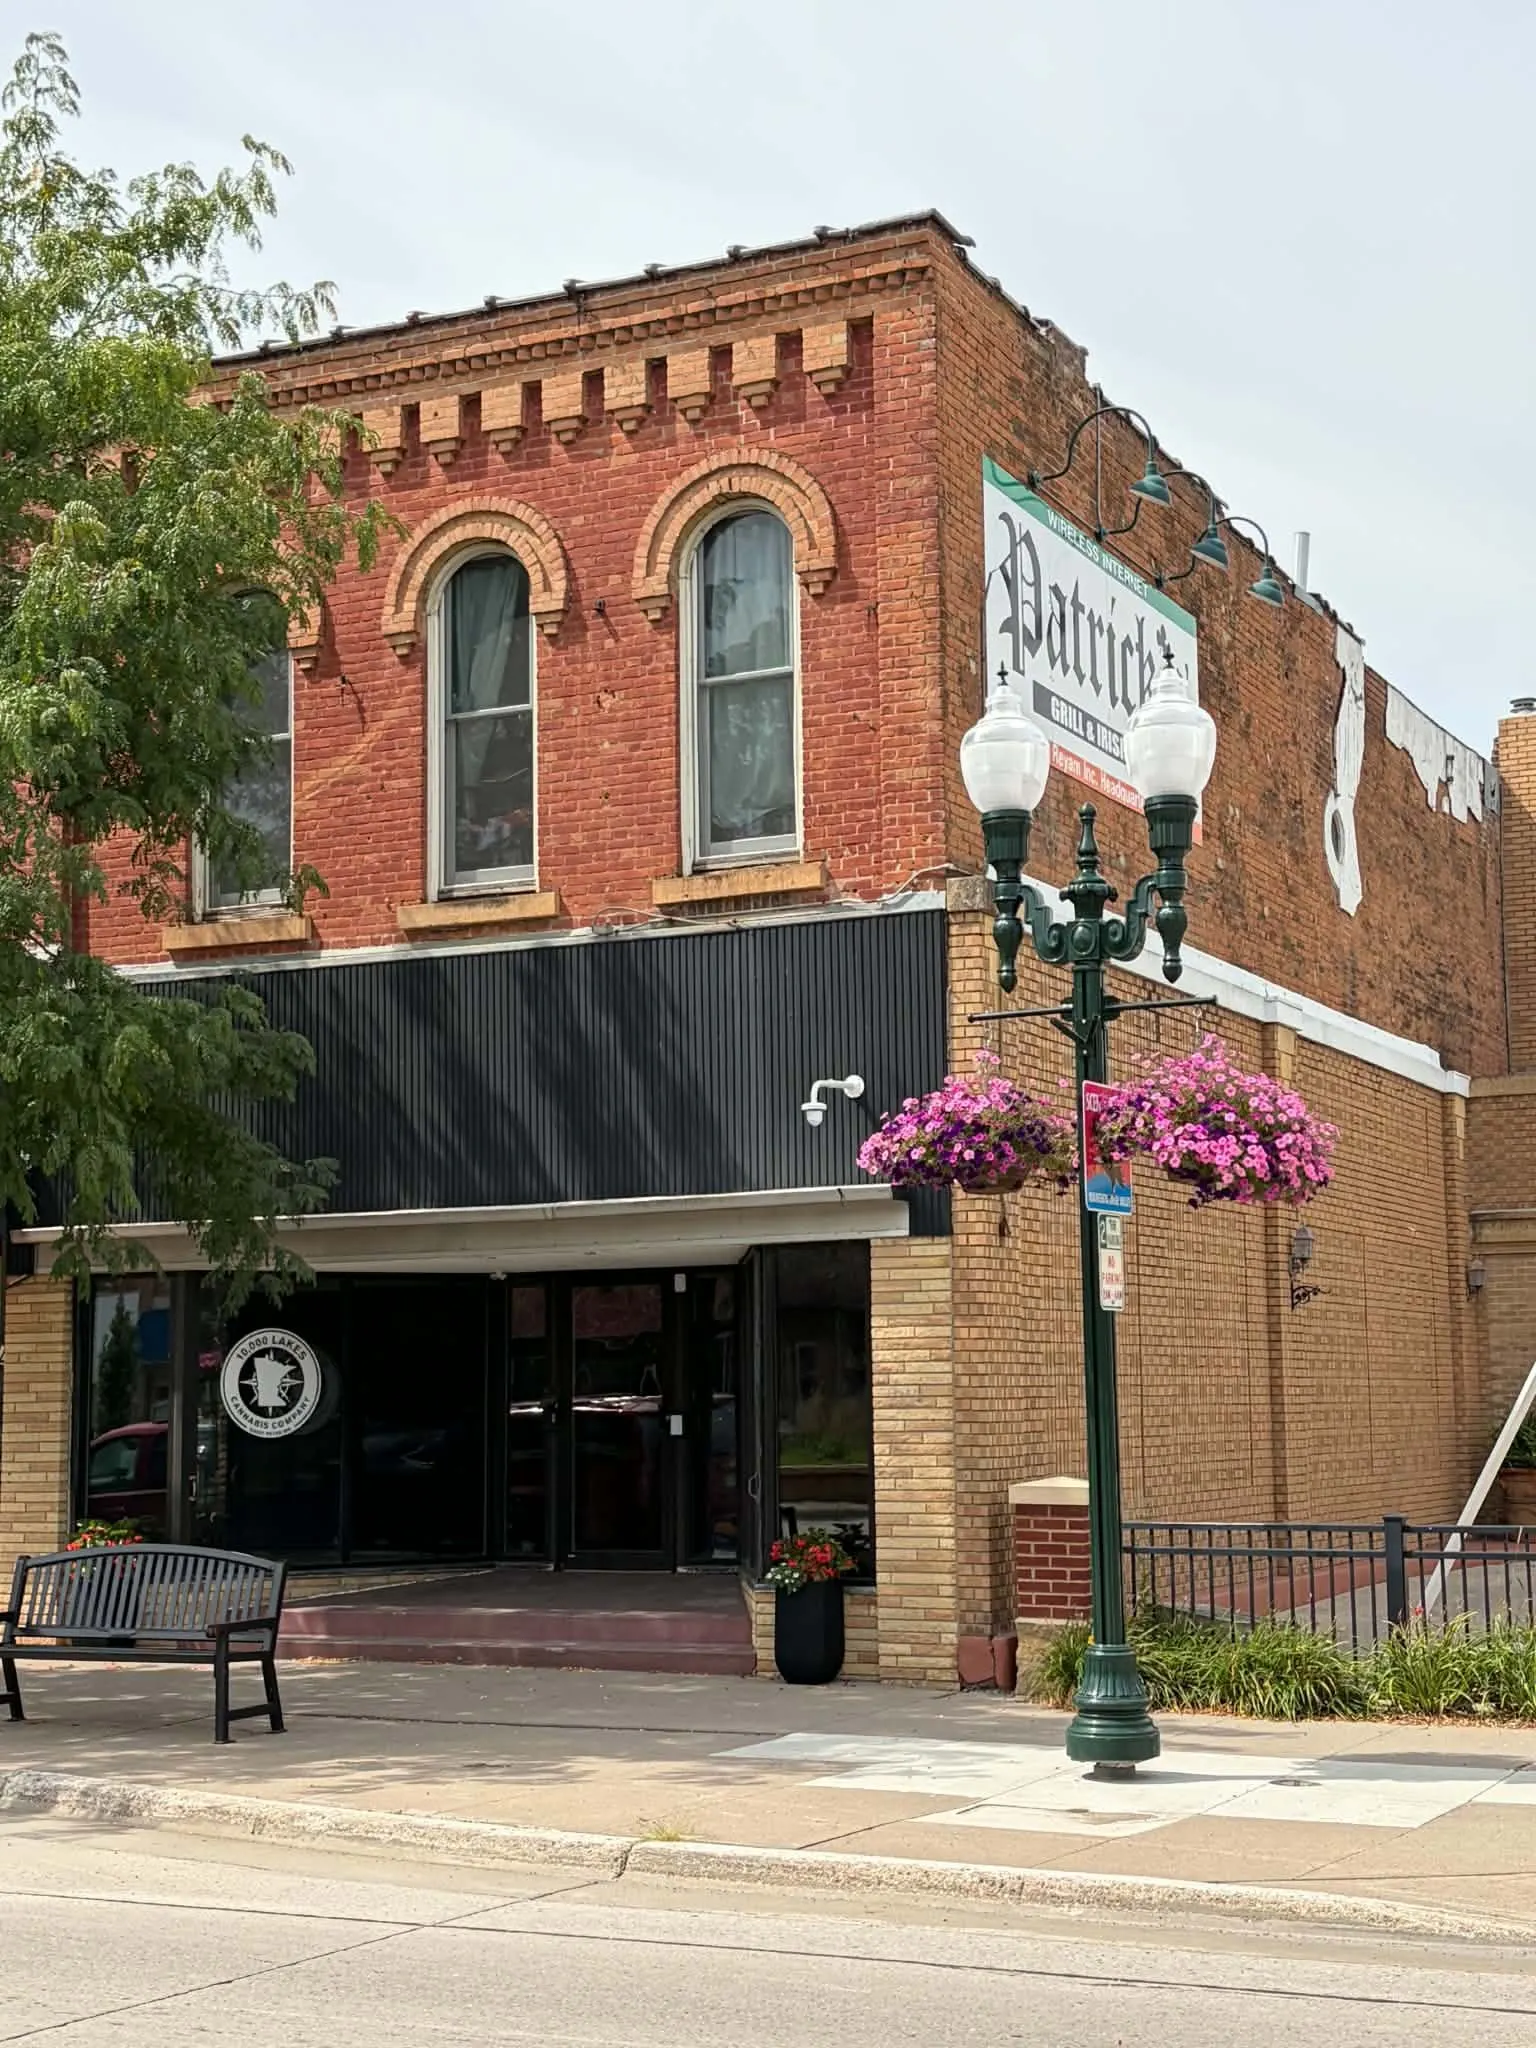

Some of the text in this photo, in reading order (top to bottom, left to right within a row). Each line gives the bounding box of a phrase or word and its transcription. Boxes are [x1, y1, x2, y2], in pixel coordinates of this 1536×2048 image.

[1047, 508, 1150, 599] WIRELESS INTERNET
[984, 511, 1189, 717] Patrick'
[1051, 695, 1085, 738] GRILL
[1086, 719, 1096, 744] &
[1083, 760, 1099, 786] Inc.
[236, 1336, 308, 1361] 10,000 LAKES
[231, 1396, 310, 1429] CANNABIS COMPANY
